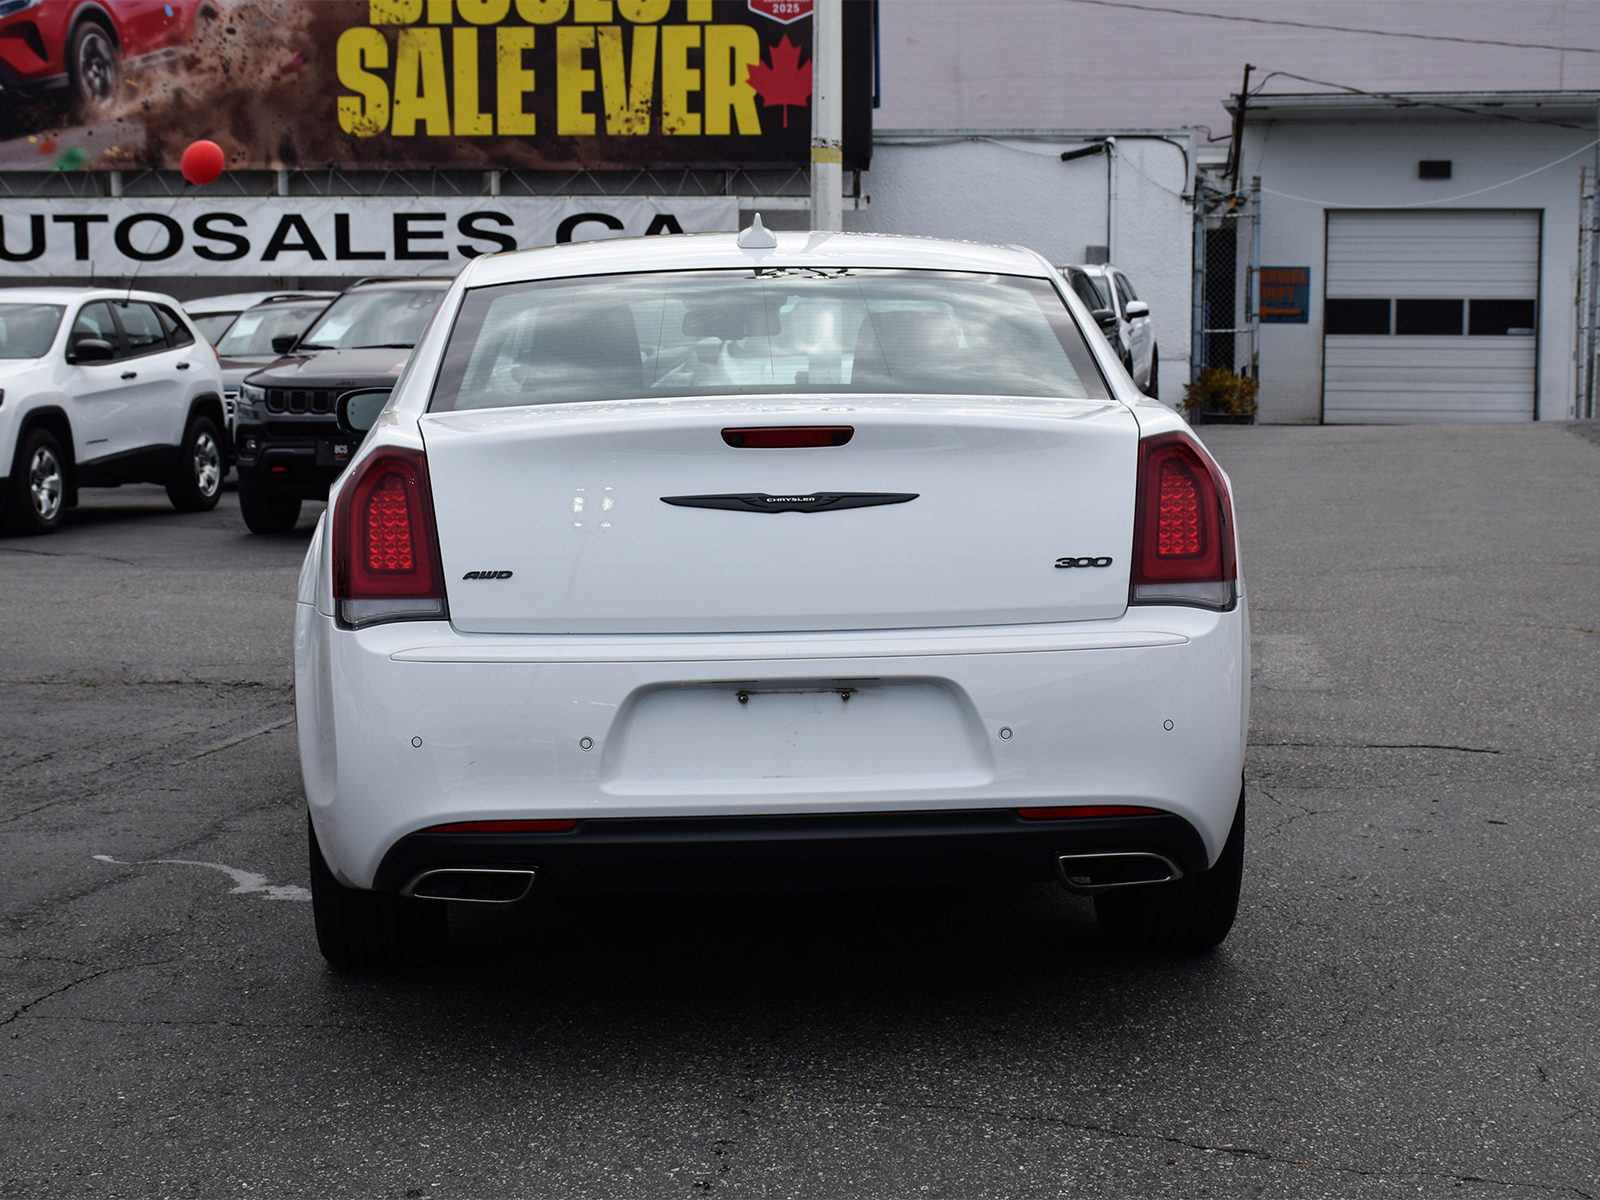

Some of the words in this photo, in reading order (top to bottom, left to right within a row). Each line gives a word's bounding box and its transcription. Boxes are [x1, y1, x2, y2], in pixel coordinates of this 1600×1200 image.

[772, 3, 800, 13] 2025
[336, 26, 536, 138] SALE
[557, 25, 762, 136] EVER
[1260, 269, 1306, 285] ERVICE
[1261, 286, 1296, 301] DEPT.
[1054, 556, 1113, 569] 300
[462, 570, 514, 580] AWD
